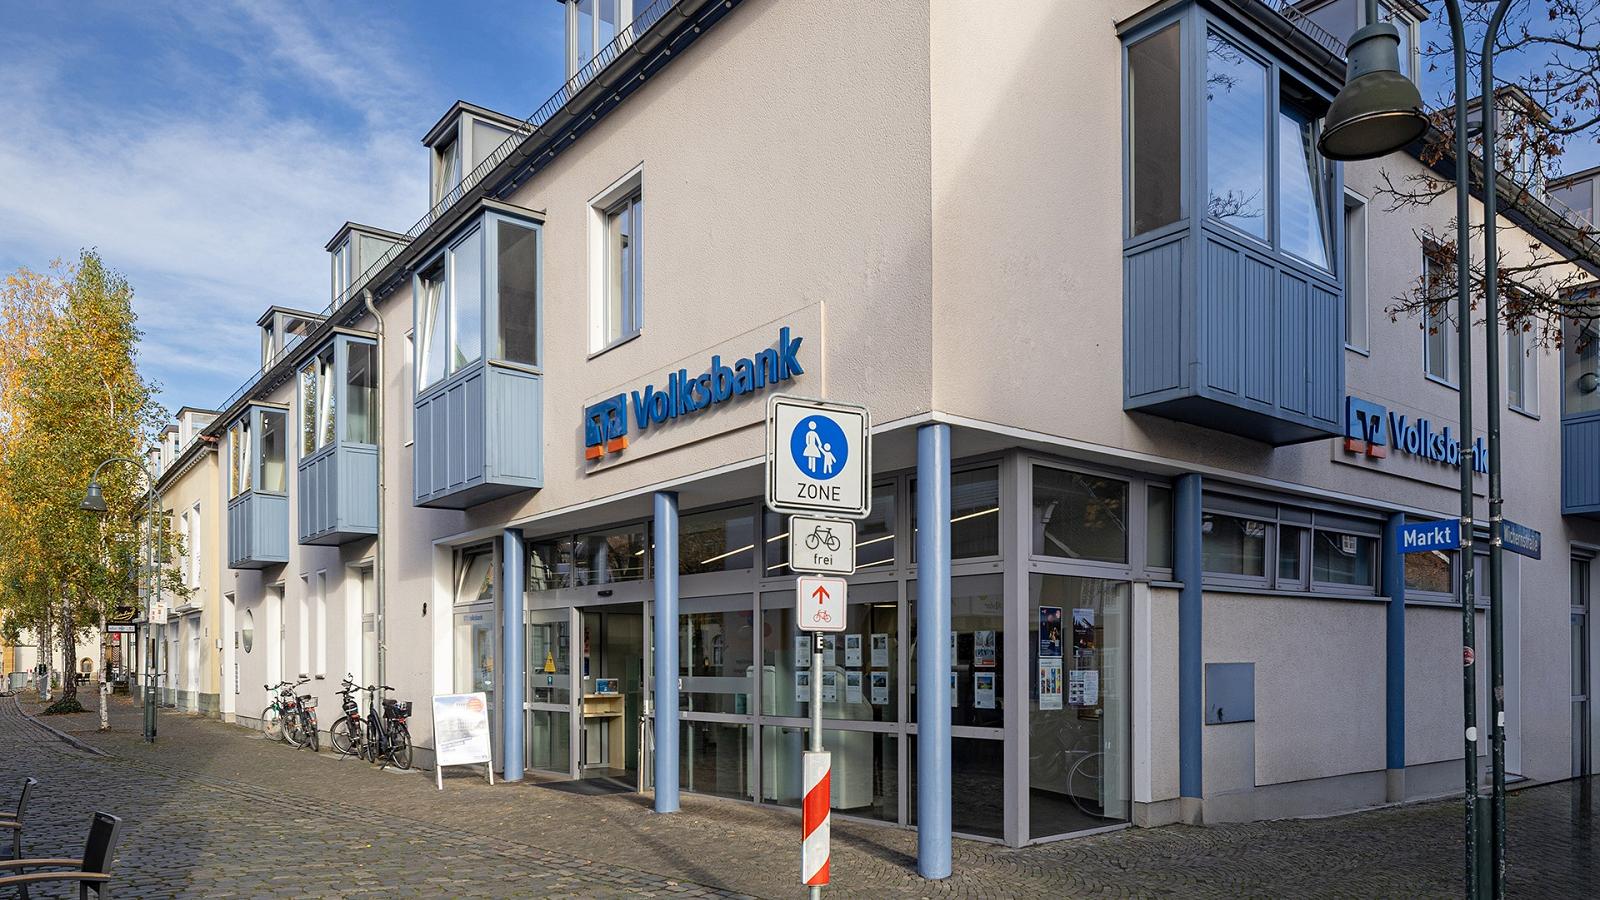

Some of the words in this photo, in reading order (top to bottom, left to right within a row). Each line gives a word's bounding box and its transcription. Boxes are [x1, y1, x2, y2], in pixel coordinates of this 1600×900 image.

[631, 326, 804, 430] Volksbank
[1389, 411, 1488, 474] Volksbnk
[797, 483, 841, 501] ZONE
[1403, 526, 1452, 548] Markt
[814, 553, 833, 566] frei
